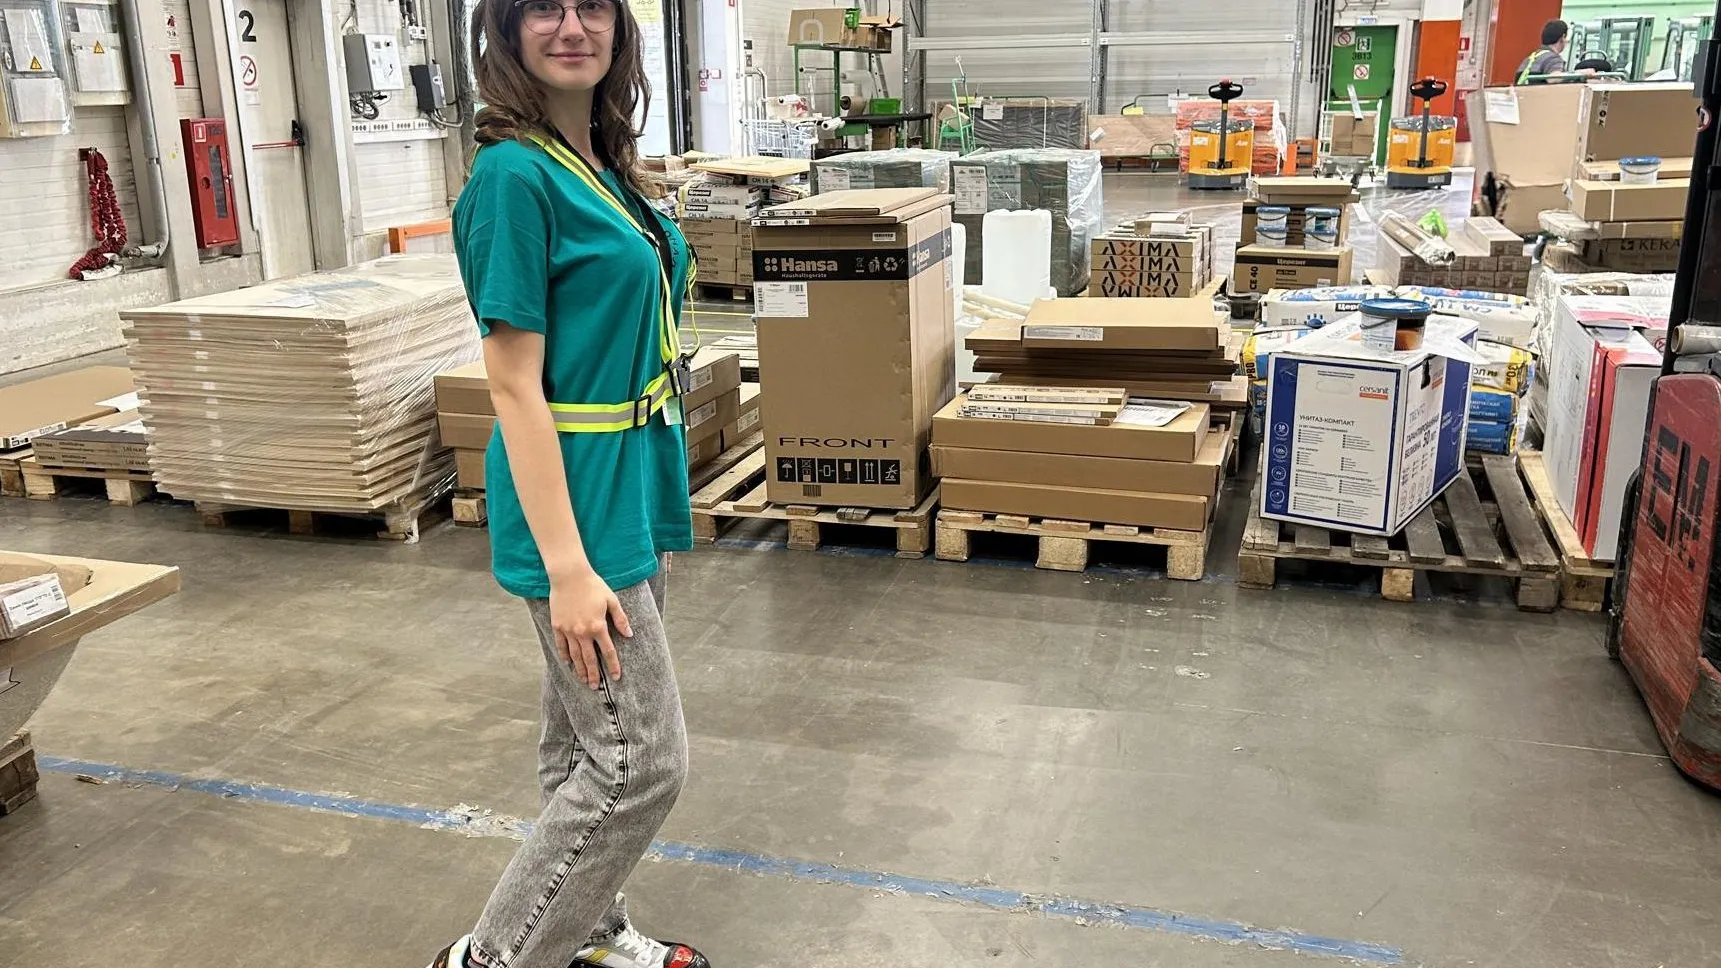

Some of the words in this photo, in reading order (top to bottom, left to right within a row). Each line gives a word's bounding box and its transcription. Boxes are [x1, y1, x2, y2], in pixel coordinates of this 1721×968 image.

[238, 10, 257, 42] 2
[1101, 241, 1180, 257] AXIMA
[780, 257, 838, 272] Hansa
[1102, 255, 1180, 272] AXIMA
[1101, 271, 1181, 287] AXIMA
[1359, 385, 1390, 394] cersanit
[1299, 415, 1355, 427] УНИТАЗ-КОМПАКТ
[779, 437, 895, 448] FRONT
